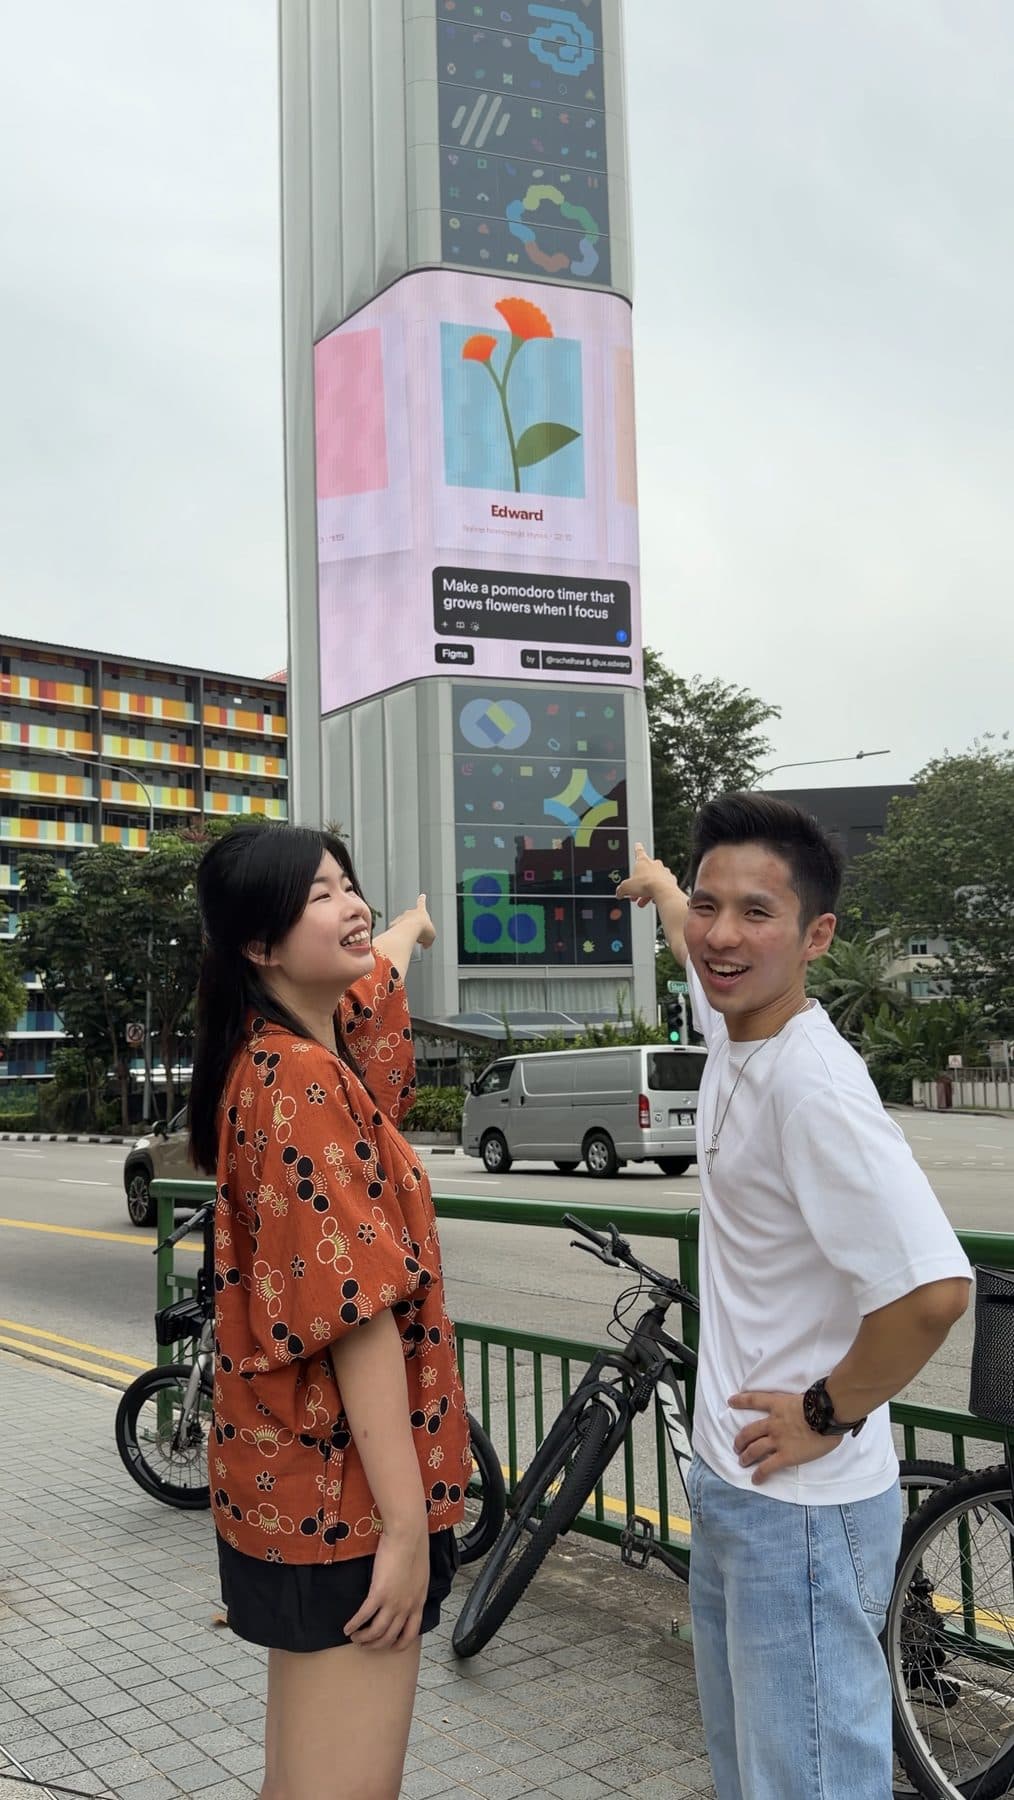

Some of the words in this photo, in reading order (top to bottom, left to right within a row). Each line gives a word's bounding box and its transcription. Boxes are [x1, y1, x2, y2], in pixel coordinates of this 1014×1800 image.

[491, 504, 544, 521] Edward
[442, 578, 478, 593] Make
[481, 583, 489, 594] a
[491, 584, 555, 599] pomodoro
[557, 587, 588, 601] timer
[590, 590, 615, 604] that
[443, 597, 483, 611] grows
[485, 597, 531, 614] flowers
[533, 602, 566, 616] when
[568, 604, 573, 616] I
[574, 604, 609, 619] focus
[442, 648, 468, 660] Figma
[526, 655, 535, 664] by
[585, 657, 591, 666] &
